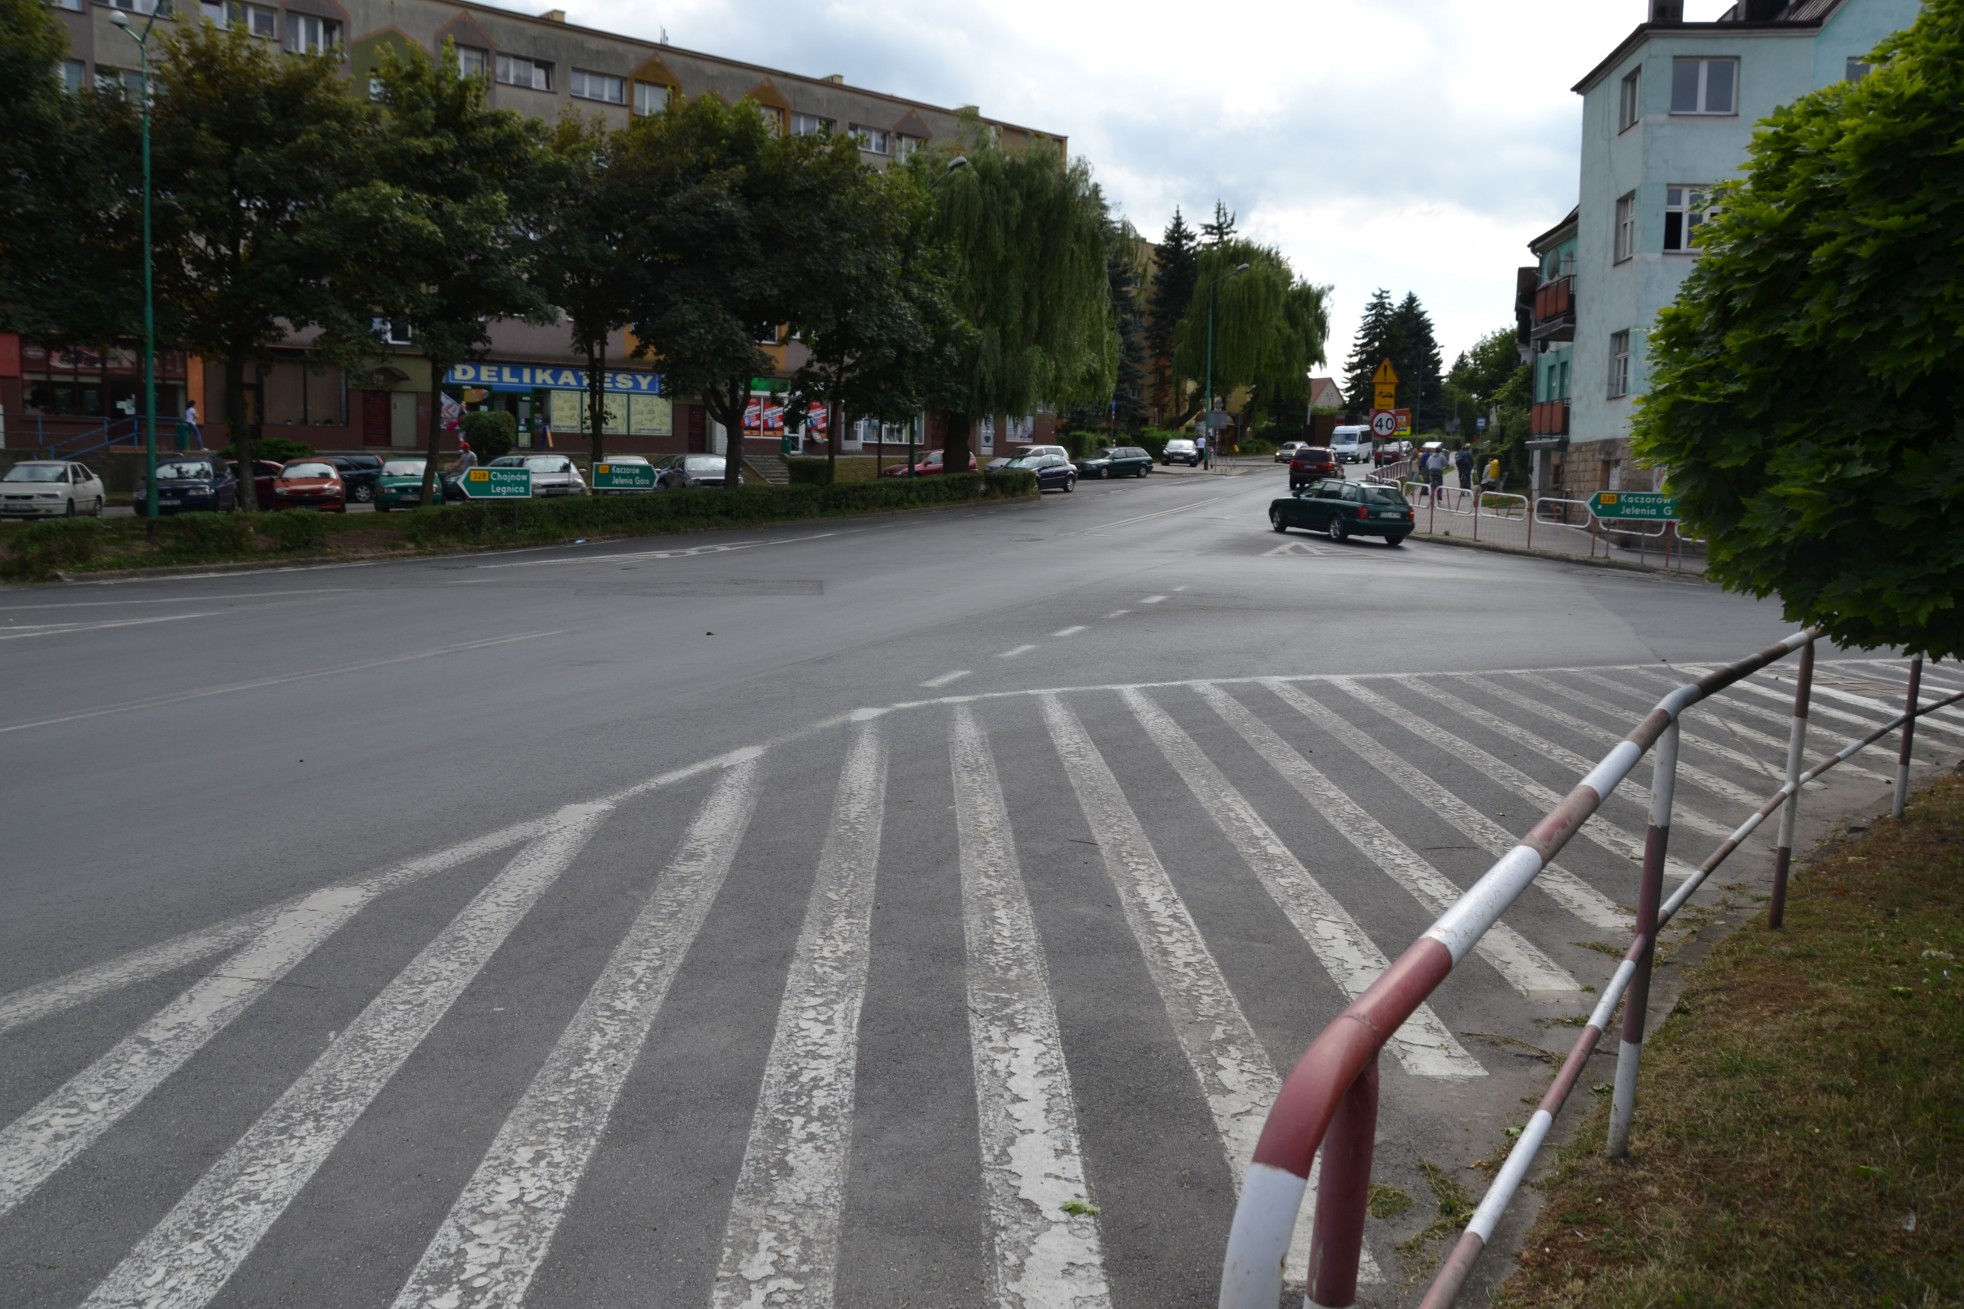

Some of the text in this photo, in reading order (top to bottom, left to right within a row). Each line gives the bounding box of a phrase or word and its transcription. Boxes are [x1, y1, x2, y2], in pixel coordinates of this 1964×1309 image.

[454, 364, 653, 390] DELIKATESY
[1375, 417, 1394, 431] 40
[612, 465, 640, 474] Kaczorów
[472, 471, 528, 483] 328 Chojnów
[612, 476, 633, 485] Jelenia
[491, 484, 525, 495] Legnica
[1620, 494, 1672, 504] Kaczorów
[1620, 505, 1657, 515] Jelenia
